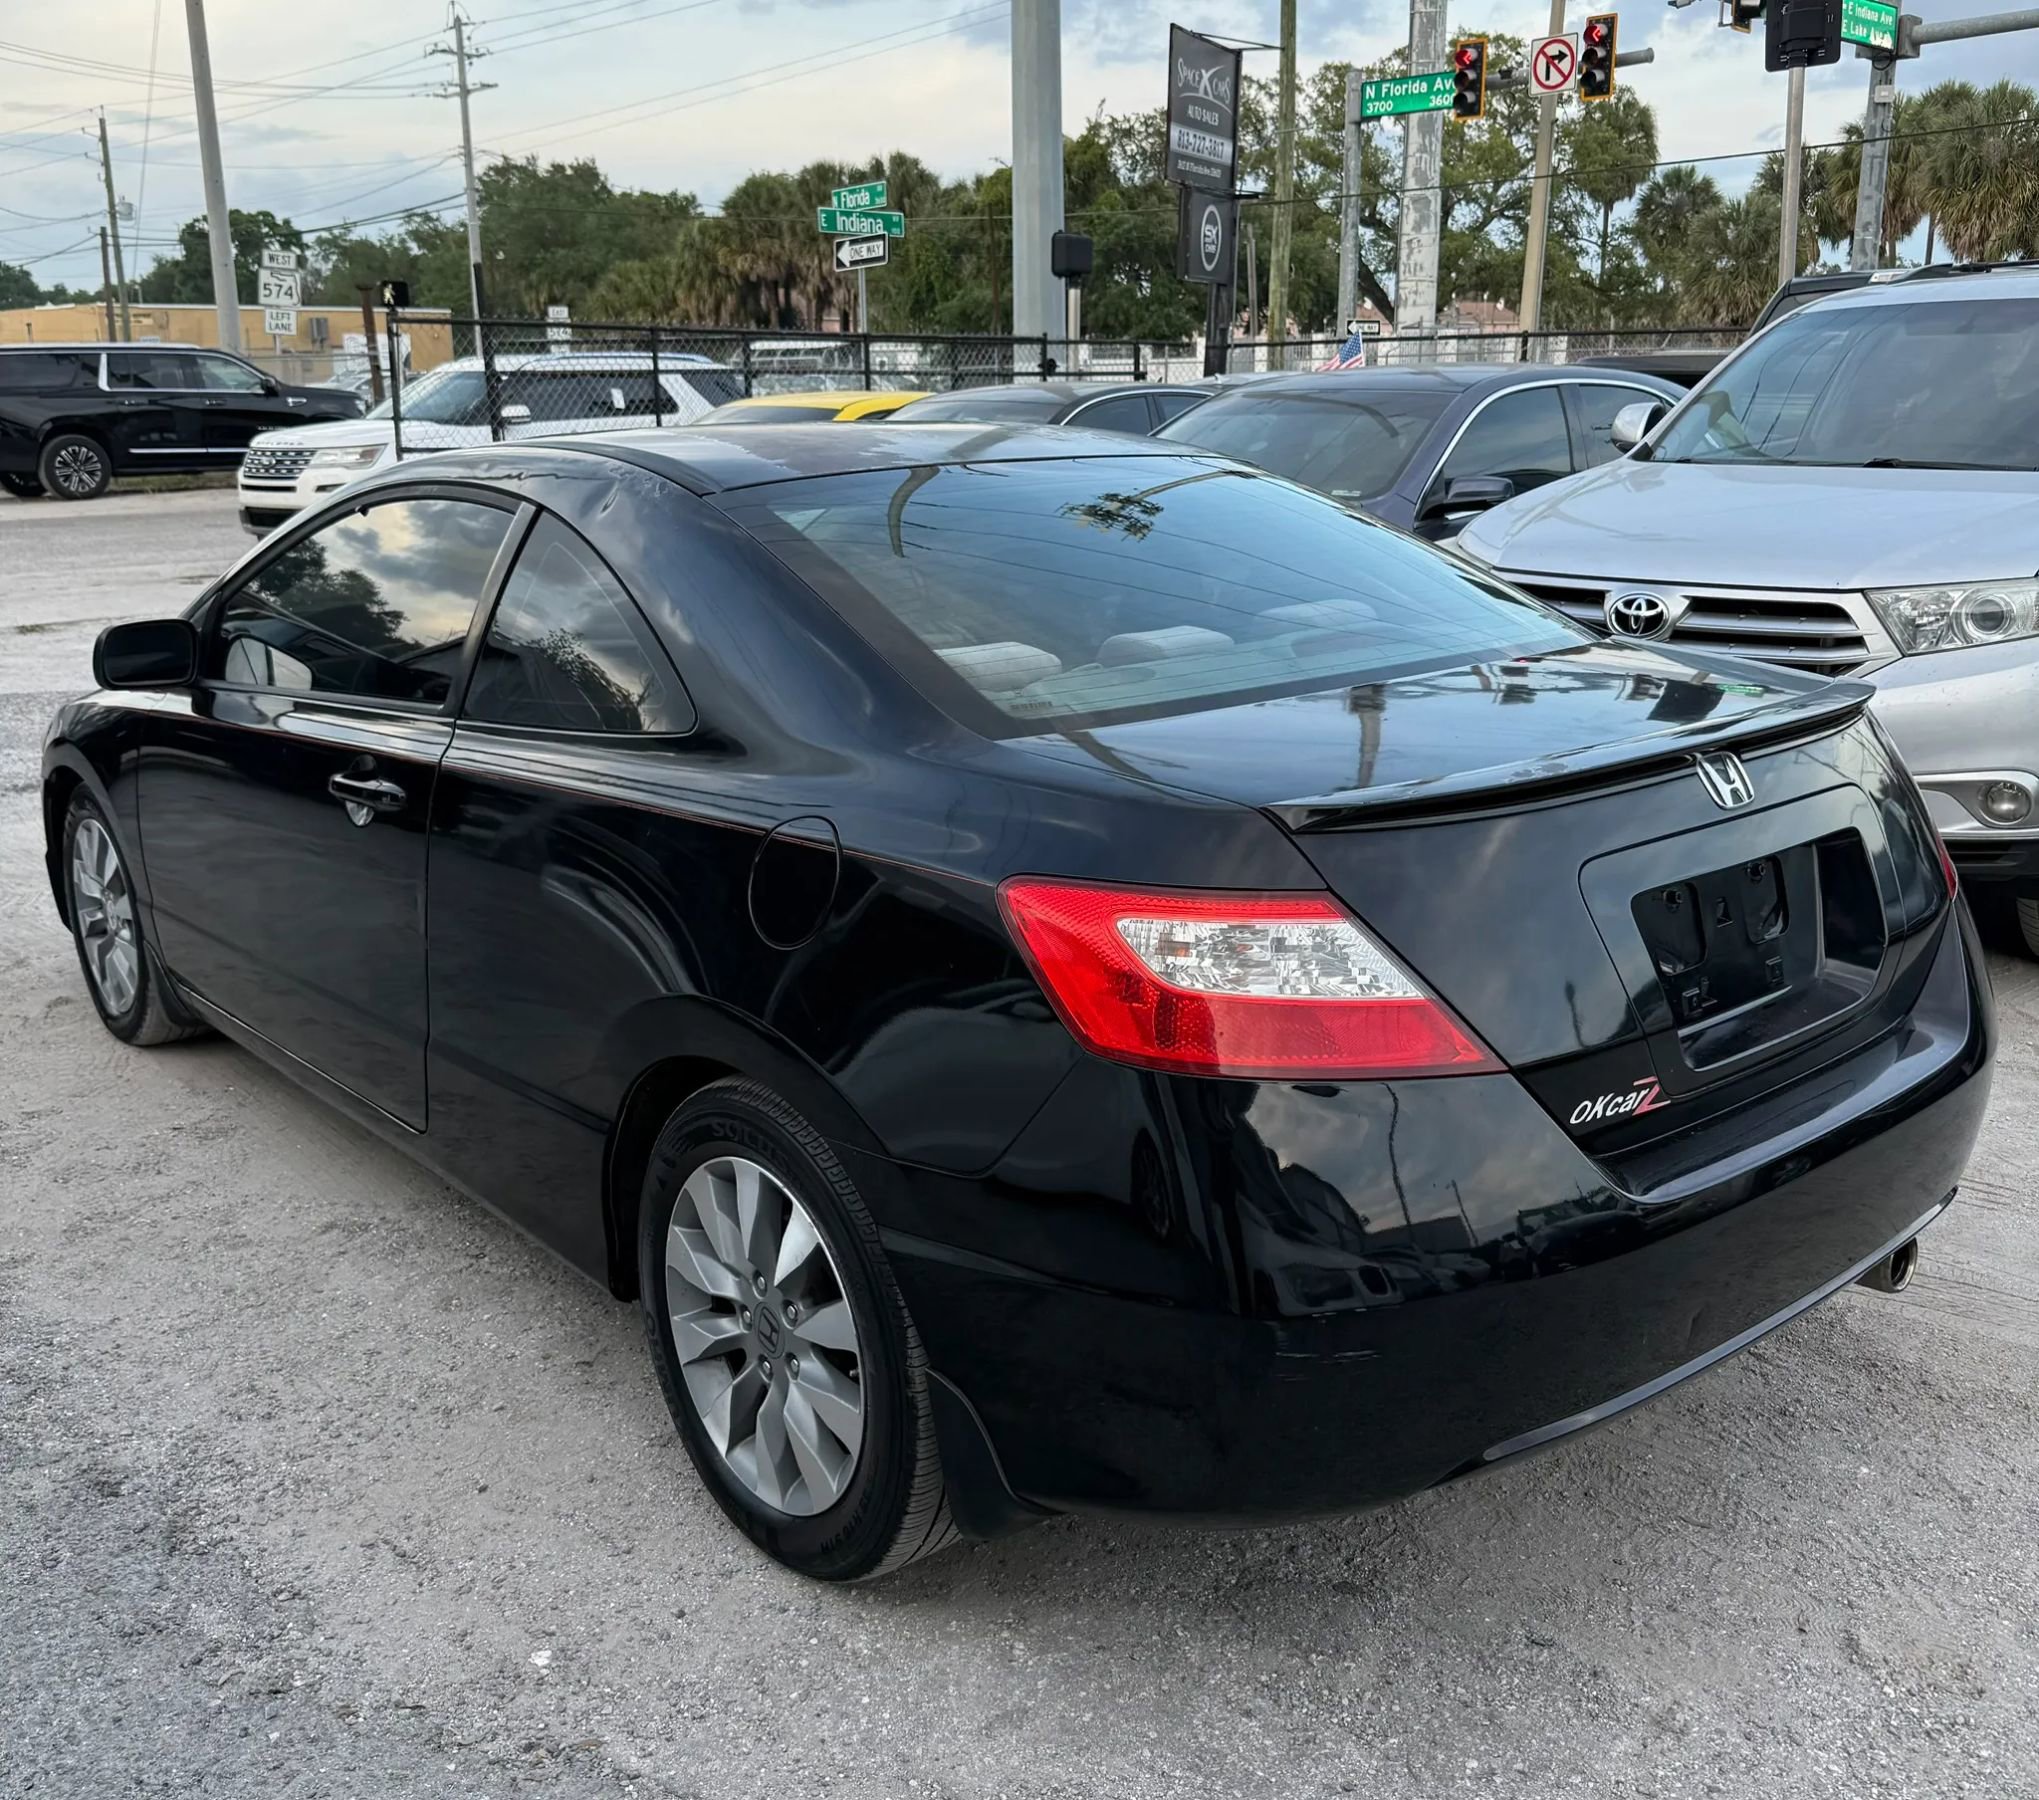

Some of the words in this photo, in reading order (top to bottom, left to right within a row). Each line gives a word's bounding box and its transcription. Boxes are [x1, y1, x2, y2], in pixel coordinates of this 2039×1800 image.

[1848, 1, 1854, 15] E
[1855, 3, 1879, 22] Indiana
[1880, 11, 1893, 26] Ave
[1850, 21, 1867, 37] Lake
[1365, 85, 1376, 99] N
[1381, 80, 1428, 97] Florida
[1366, 100, 1393, 113] 3700
[840, 189, 871, 209] Florida
[821, 214, 828, 227] E
[836, 211, 884, 234] Indiana
[268, 252, 292, 265] WEST
[850, 247, 864, 259] ONE
[866, 244, 881, 256] WAY
[263, 283, 293, 300] 574
[270, 311, 291, 321] LEFT
[269, 322, 292, 332] LANE
